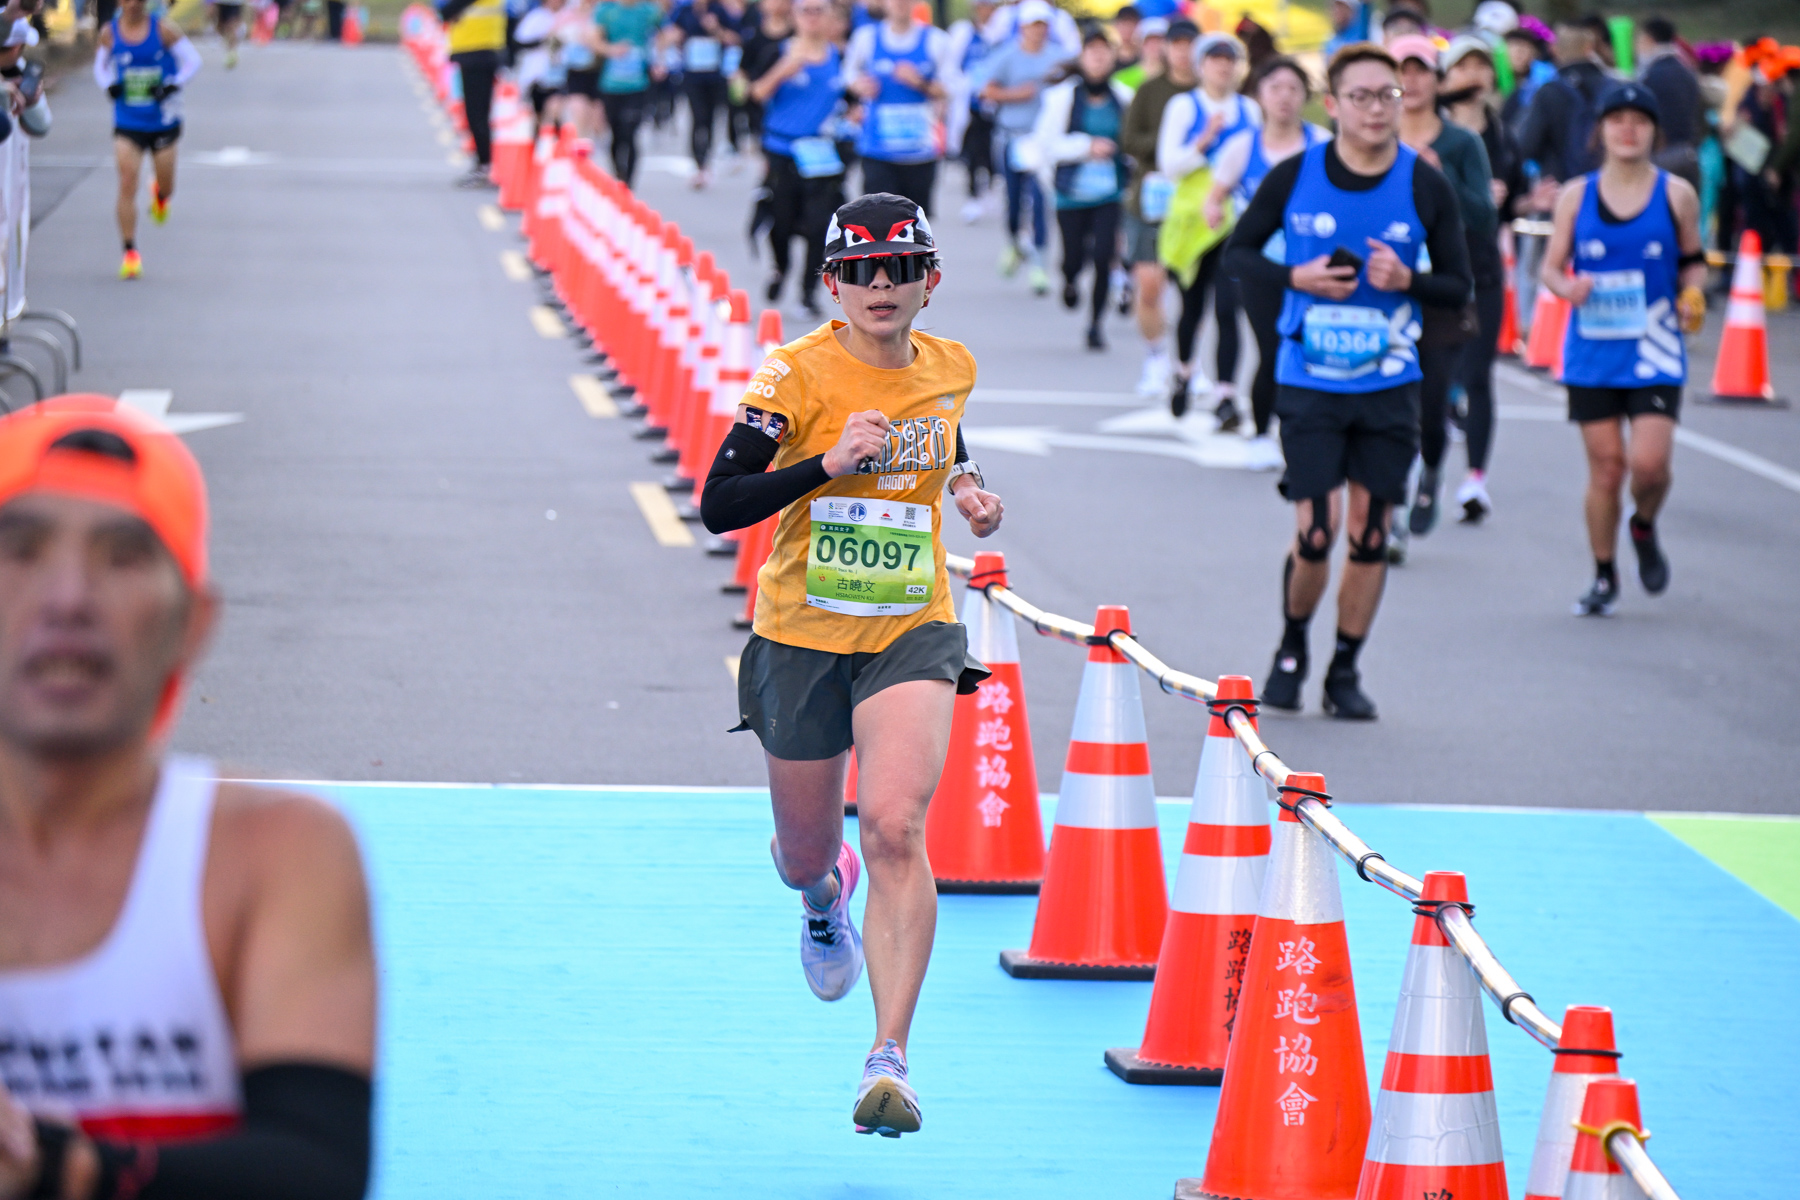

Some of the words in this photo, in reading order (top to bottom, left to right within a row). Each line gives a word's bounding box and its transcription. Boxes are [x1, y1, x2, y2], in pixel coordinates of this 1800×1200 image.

[1311, 330, 1381, 354] 10364
[877, 474, 918, 491] NAGOYA
[816, 535, 921, 571] 06097
[836, 577, 876, 593] 古曉文
[908, 586, 925, 594] 42K
[974, 681, 1014, 829] 路跑協會
[1273, 936, 1322, 1127] 路跑協會
